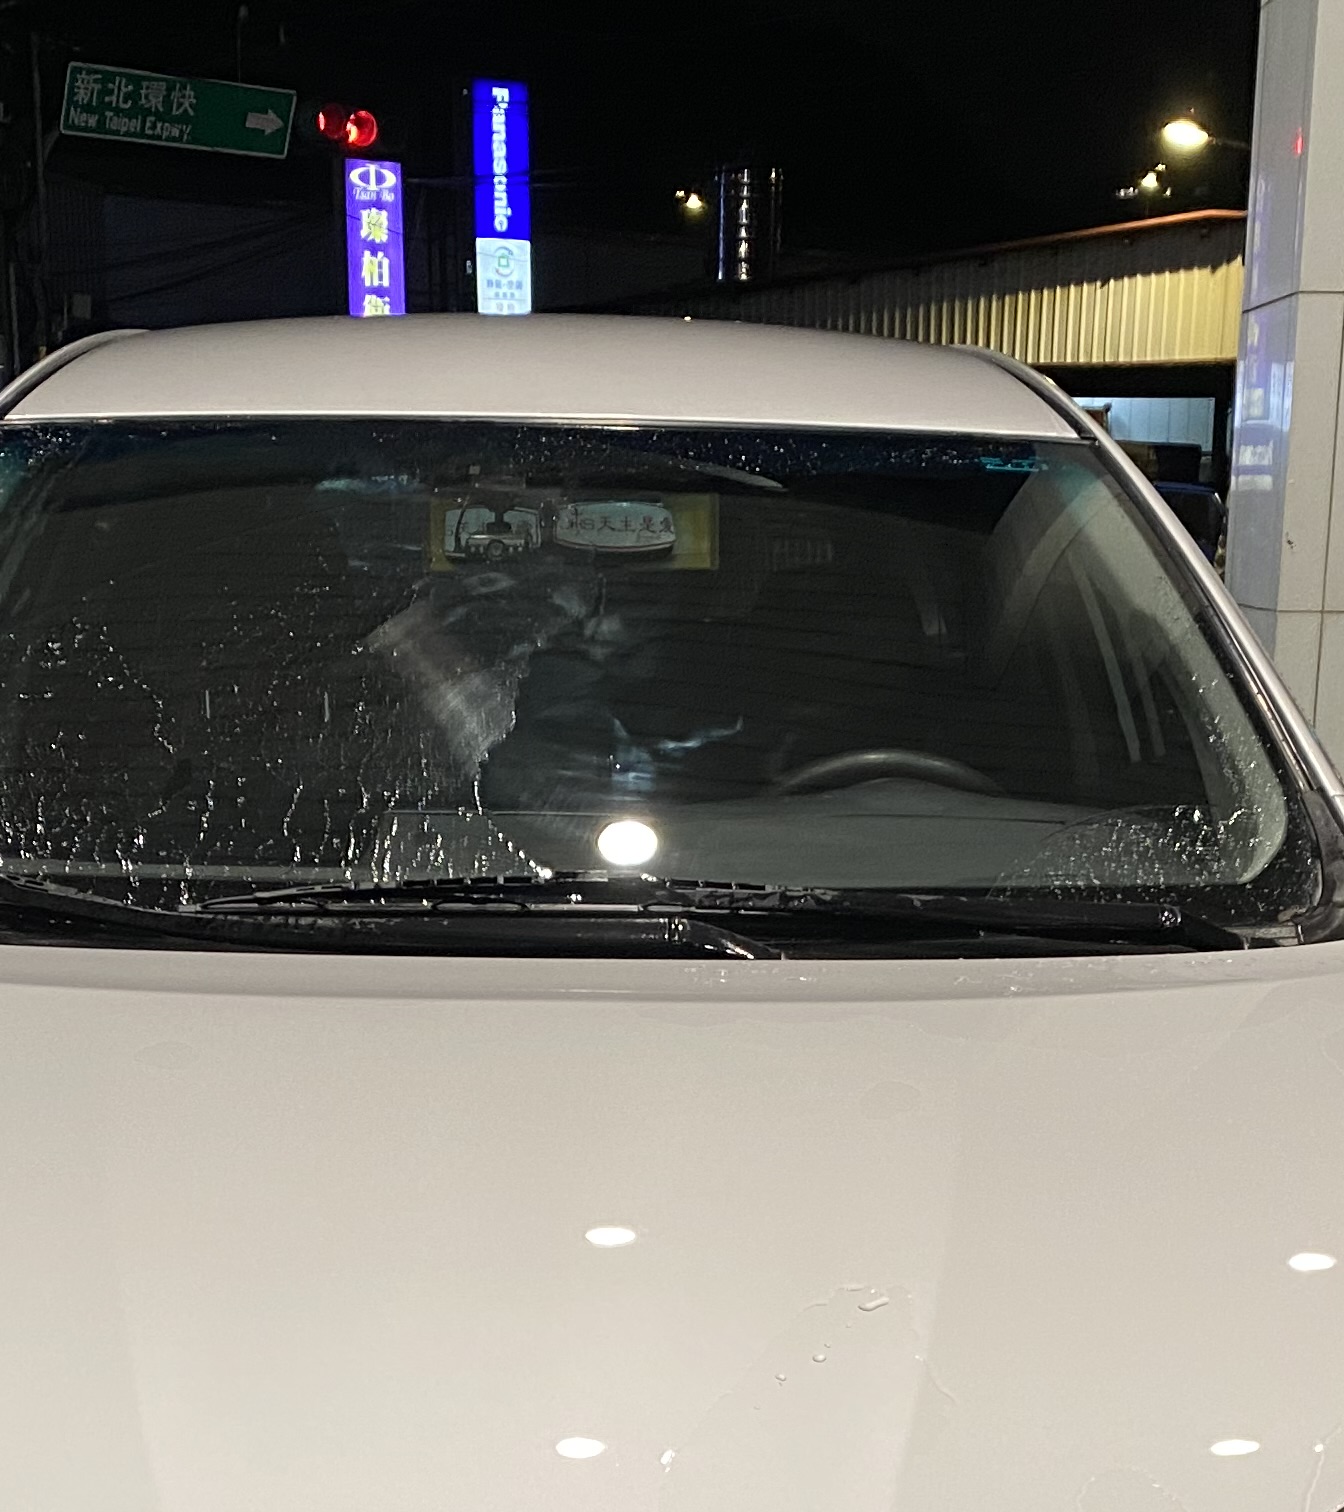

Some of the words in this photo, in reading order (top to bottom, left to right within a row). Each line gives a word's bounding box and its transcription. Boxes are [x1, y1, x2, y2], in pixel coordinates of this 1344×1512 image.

[73, 71, 197, 117] 新北環快
[68, 106, 99, 128] New
[105, 111, 142, 135] Taipei
[491, 87, 512, 233] Panasonic
